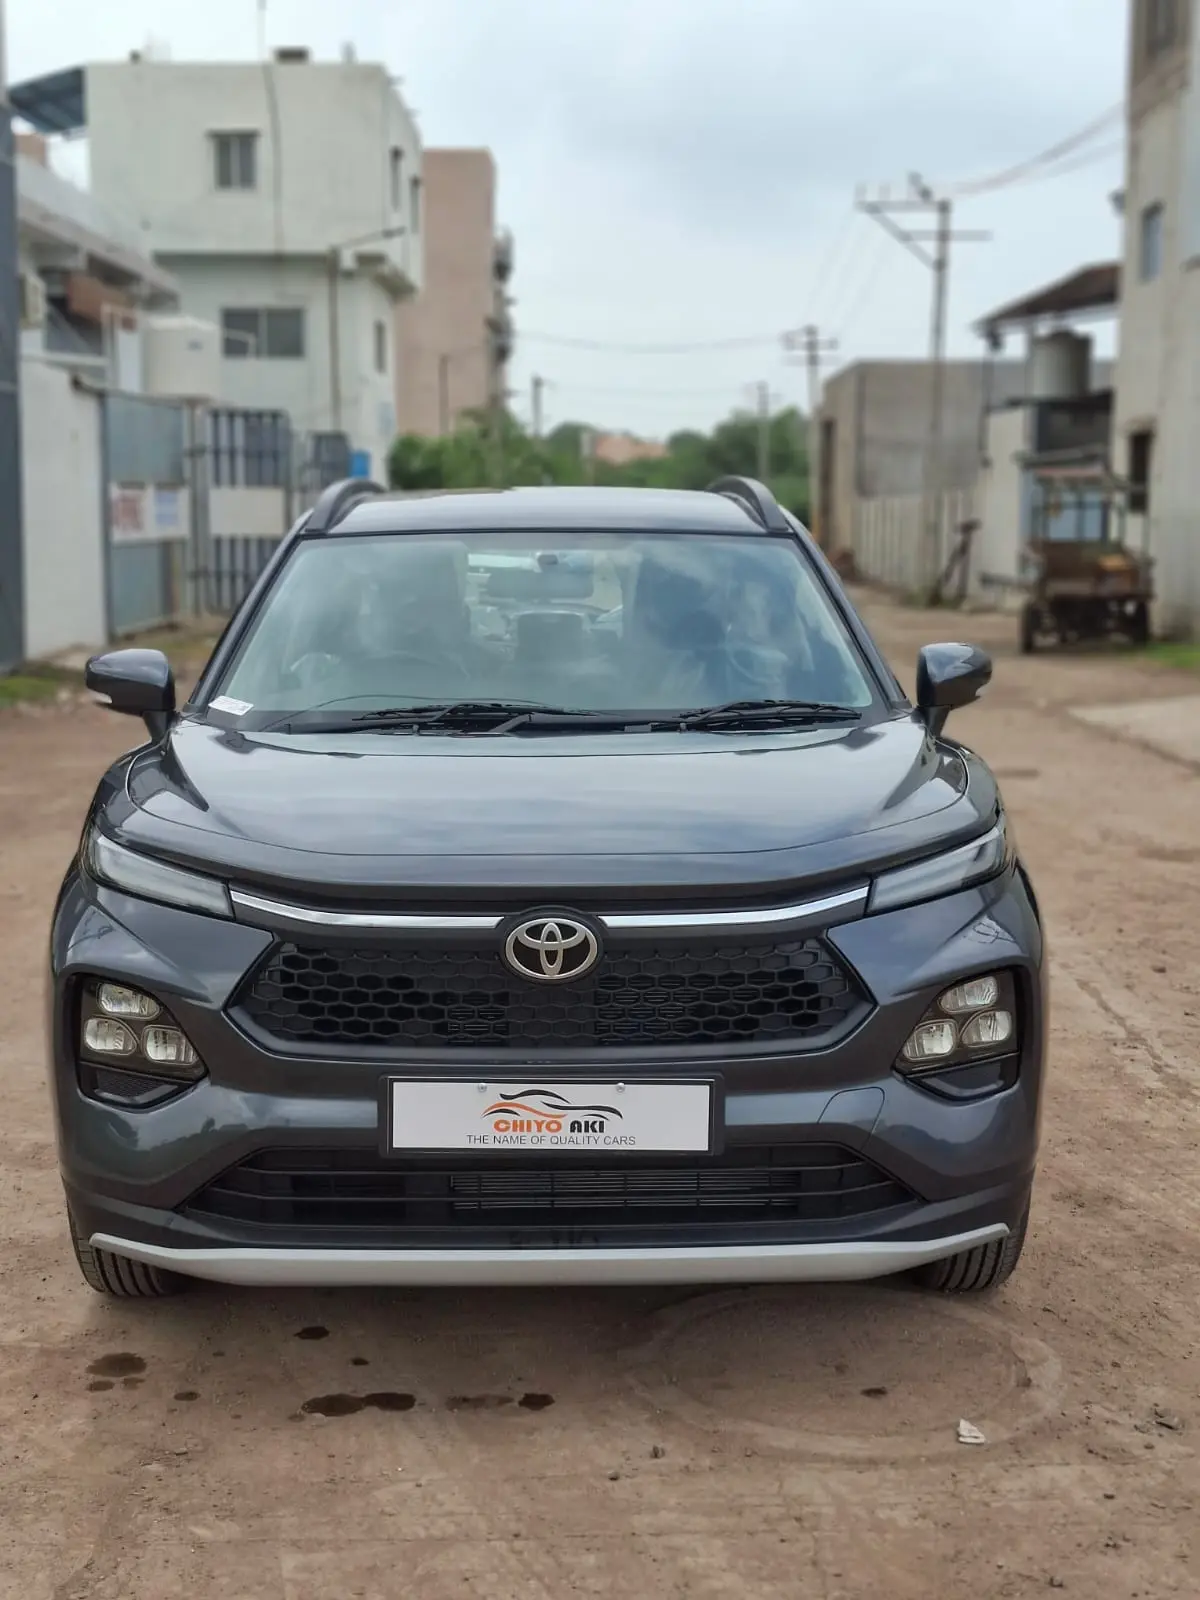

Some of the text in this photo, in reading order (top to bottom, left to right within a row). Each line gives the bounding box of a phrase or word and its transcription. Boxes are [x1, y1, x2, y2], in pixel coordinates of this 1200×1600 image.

[493, 1119, 605, 1134] CHIYO AKI
[466, 1135, 636, 1146] THE NAME OF QUALITY CARS
